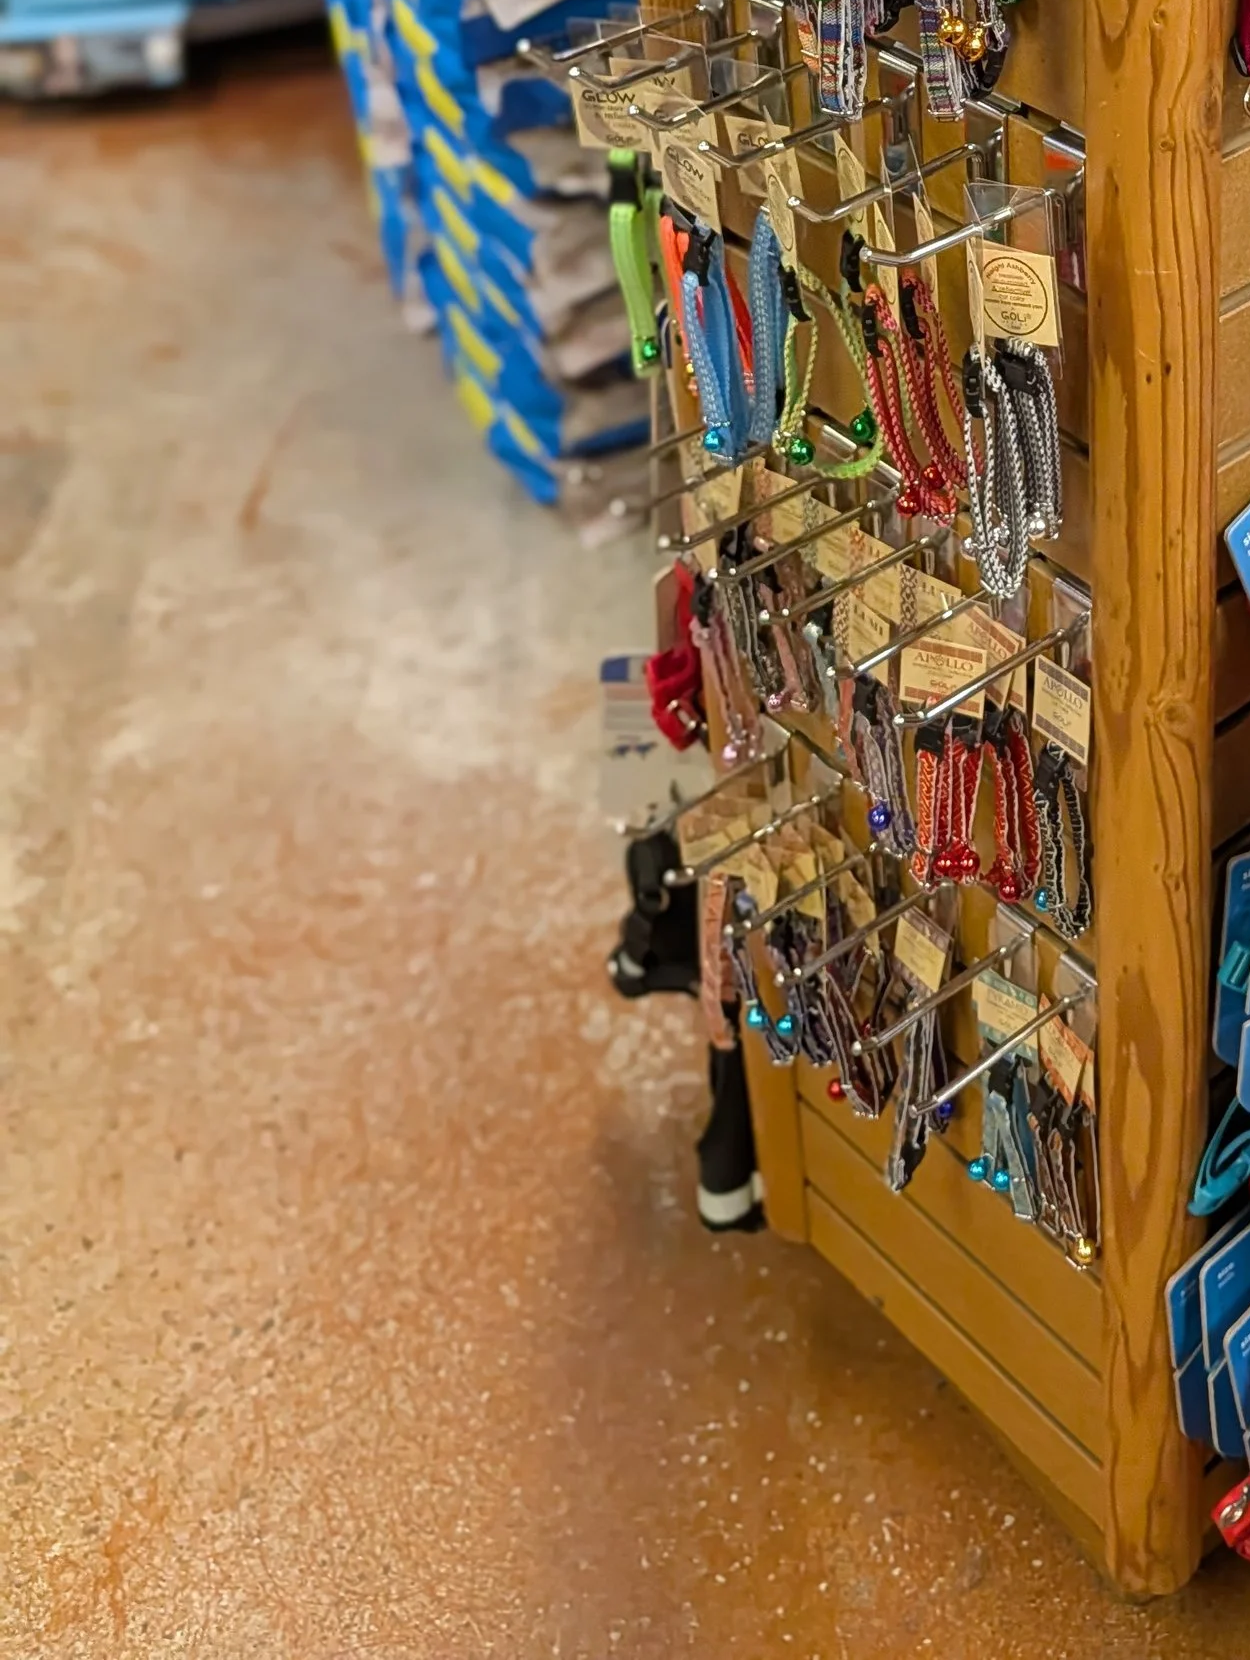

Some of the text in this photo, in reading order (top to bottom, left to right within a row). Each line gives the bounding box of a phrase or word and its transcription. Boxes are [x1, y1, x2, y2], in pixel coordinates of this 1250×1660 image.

[582, 89, 636, 105] GLOW
[738, 132, 770, 149] GLO
[666, 145, 705, 182] GLOW
